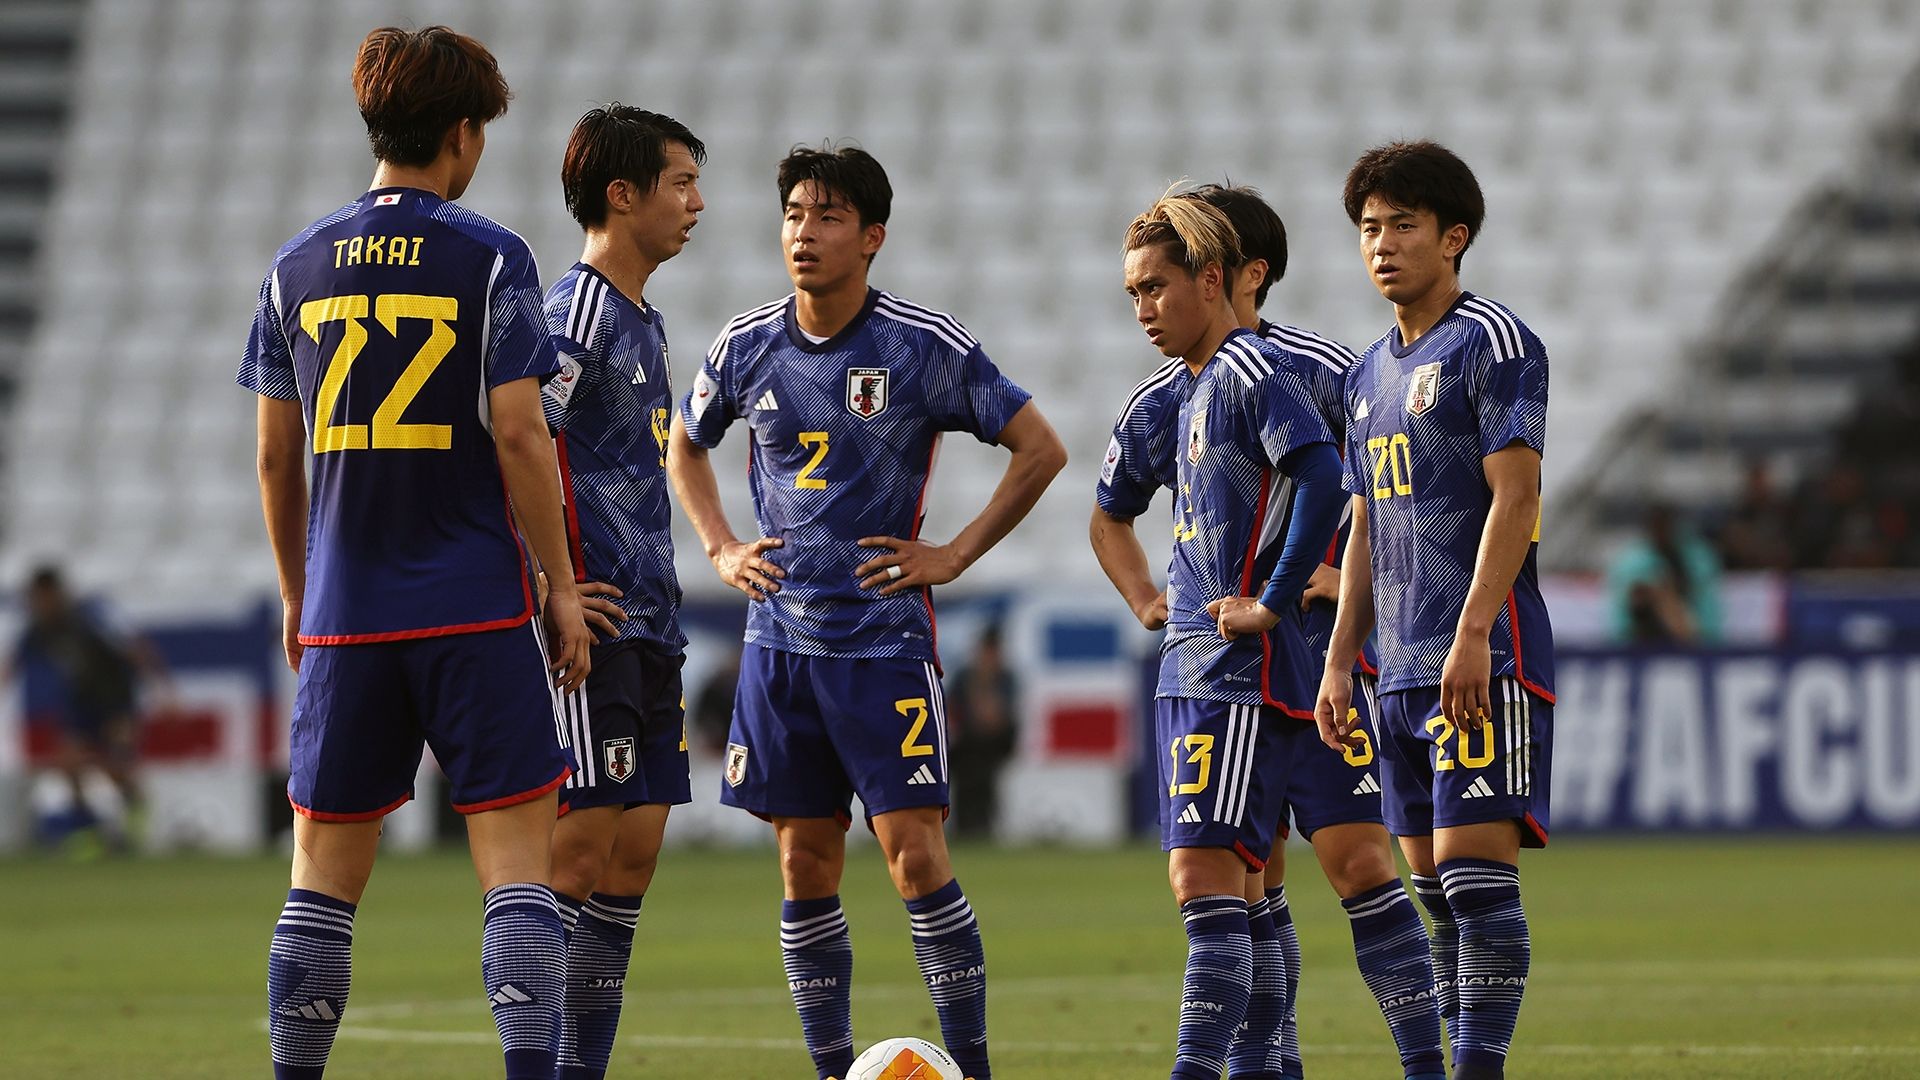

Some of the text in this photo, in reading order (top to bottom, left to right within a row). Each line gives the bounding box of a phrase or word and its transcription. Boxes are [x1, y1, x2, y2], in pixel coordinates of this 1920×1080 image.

[333, 235, 425, 269] TAKAI
[299, 293, 459, 455] 22
[794, 431, 829, 490] 2
[1367, 432, 1412, 501] 20
[895, 697, 934, 757] 2
[1425, 707, 1495, 772] 20
[1169, 734, 1215, 798] 13
[930, 964, 985, 985] JAPAN
[1381, 984, 1438, 1011] JAPAN
[1459, 976, 1528, 986] JAPAN
[920, 1041, 951, 1066] molten
